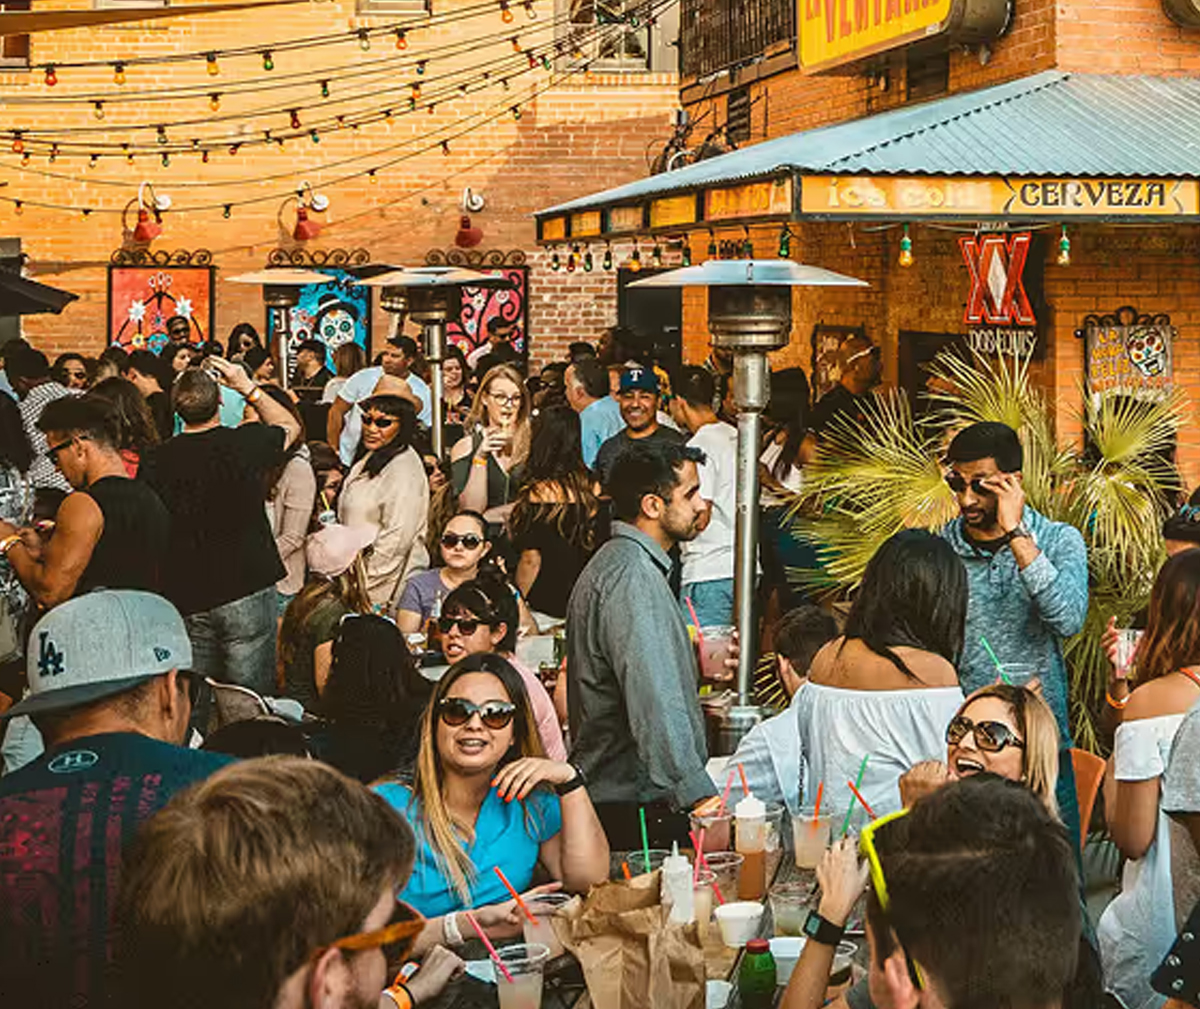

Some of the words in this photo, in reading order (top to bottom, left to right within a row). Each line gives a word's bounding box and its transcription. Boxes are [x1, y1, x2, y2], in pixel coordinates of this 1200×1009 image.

[1018, 181, 1166, 207] CERVEZA
[630, 369, 643, 382] T
[37, 631, 65, 678] LA
